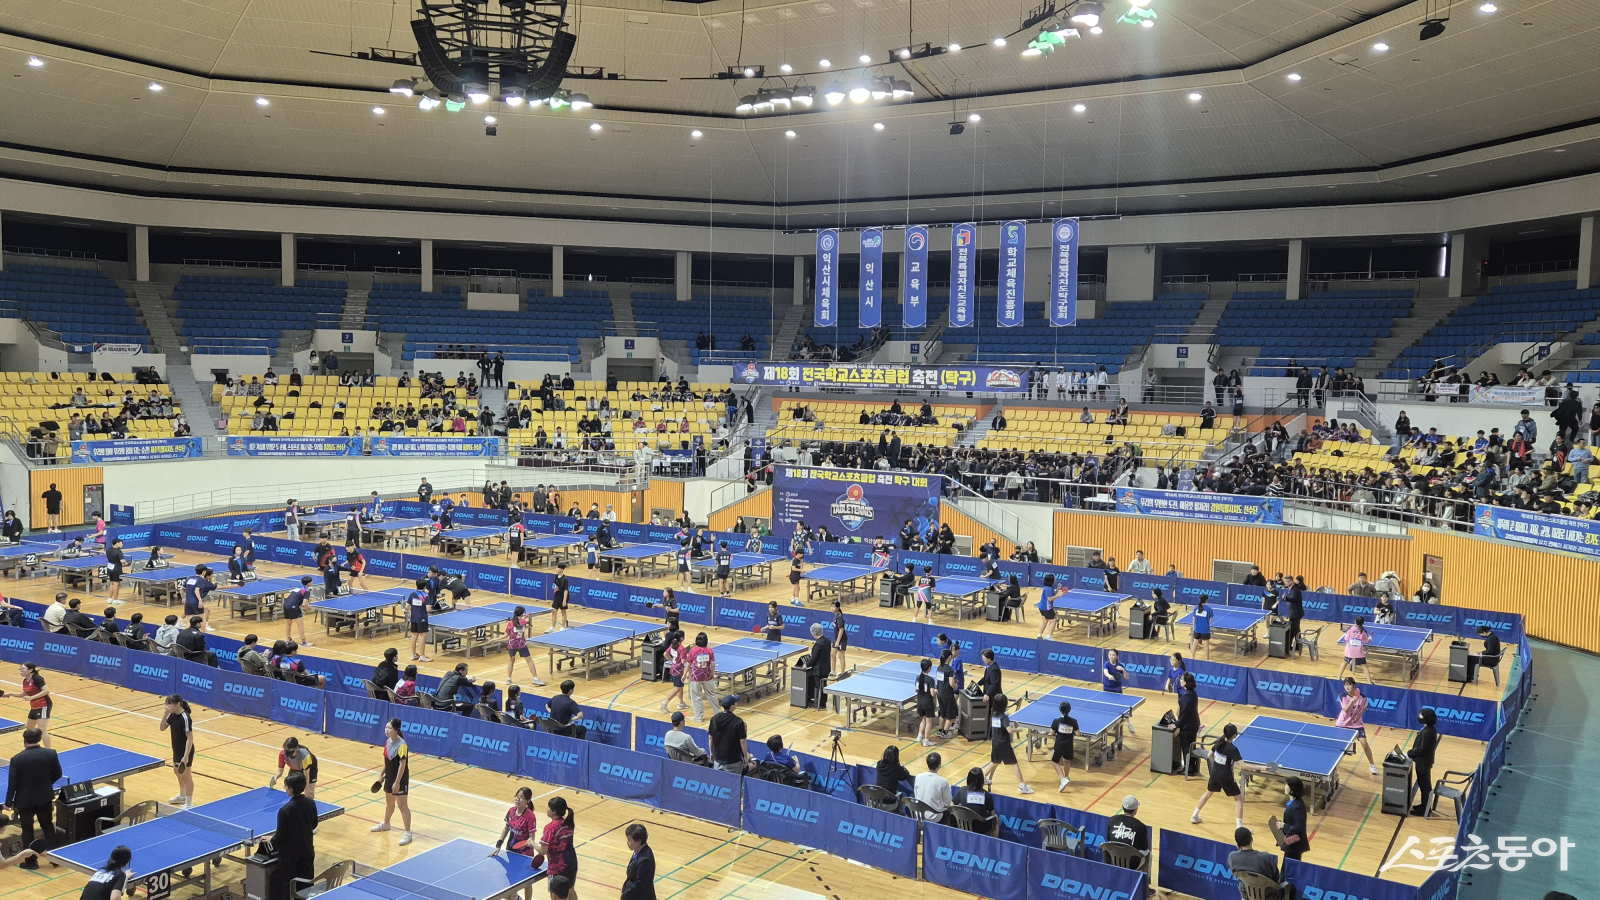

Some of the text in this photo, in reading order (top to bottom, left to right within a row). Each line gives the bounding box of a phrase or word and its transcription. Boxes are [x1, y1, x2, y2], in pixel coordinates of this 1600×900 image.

[821, 253, 831, 321] 익산시체육회
[865, 262, 874, 308] 익산시
[910, 262, 920, 307] 교육부
[957, 248, 968, 322] 전북특별자치도교육청
[1005, 247, 1017, 320] 학교체육진흥회
[1057, 244, 1070, 320] 전북특별자치도탁구협회
[764, 366, 799, 380] 제18회
[802, 367, 909, 384] 전국학교스포츠클럽
[912, 369, 937, 385] 축전
[941, 370, 976, 386] (탁구)
[785, 468, 928, 488] 제18회 전국학교스포츠클럽 축전 탁구 대회
[1244, 506, 1258, 515] 선수단
[234, 518, 261, 527] DONIC
[528, 519, 550, 527] DONIC
[118, 532, 151, 541] DONIC
[618, 529, 640, 537] DONIC
[214, 539, 236, 547] DONIC
[276, 546, 298, 555] DONIC
[825, 550, 854, 558] DONIC
[370, 558, 397, 570] DONIC
[946, 563, 976, 572] DONIC
[99, 567, 108, 575] 21
[479, 573, 504, 584] DONIC
[515, 578, 542, 589] DONIC
[1132, 582, 1169, 592] DONIC
[1182, 588, 1221, 598] DONIC
[266, 595, 274, 604] 19
[588, 589, 618, 601] DONIC
[630, 595, 661, 607] DONIC
[367, 609, 376, 618] 18
[720, 607, 756, 620] DONIC
[1406, 612, 1453, 623] DONIC
[1464, 618, 1513, 631] DONIC
[477, 628, 486, 637] 17
[873, 629, 916, 642] DONIC
[1, 638, 34, 651] DONIC
[44, 642, 78, 656] DONIC
[89, 654, 122, 667] DONIC
[1048, 652, 1096, 667] DONIC
[133, 664, 170, 680] DONIC
[745, 670, 753, 680] 15
[182, 673, 213, 690] DONIC
[224, 682, 265, 698] DONIC
[1257, 681, 1314, 696] DONIC
[280, 697, 318, 713] DONIC
[334, 708, 380, 725] DONIC
[401, 721, 449, 738] DONIC
[461, 733, 510, 754] DONIC
[526, 746, 579, 766] DONIC
[599, 762, 654, 785] DONIC
[672, 776, 732, 799] DONIC
[755, 798, 820, 824] DONIC
[838, 820, 904, 850] DONIC
[935, 846, 1012, 876] DONIC
[149, 872, 169, 894] 30
